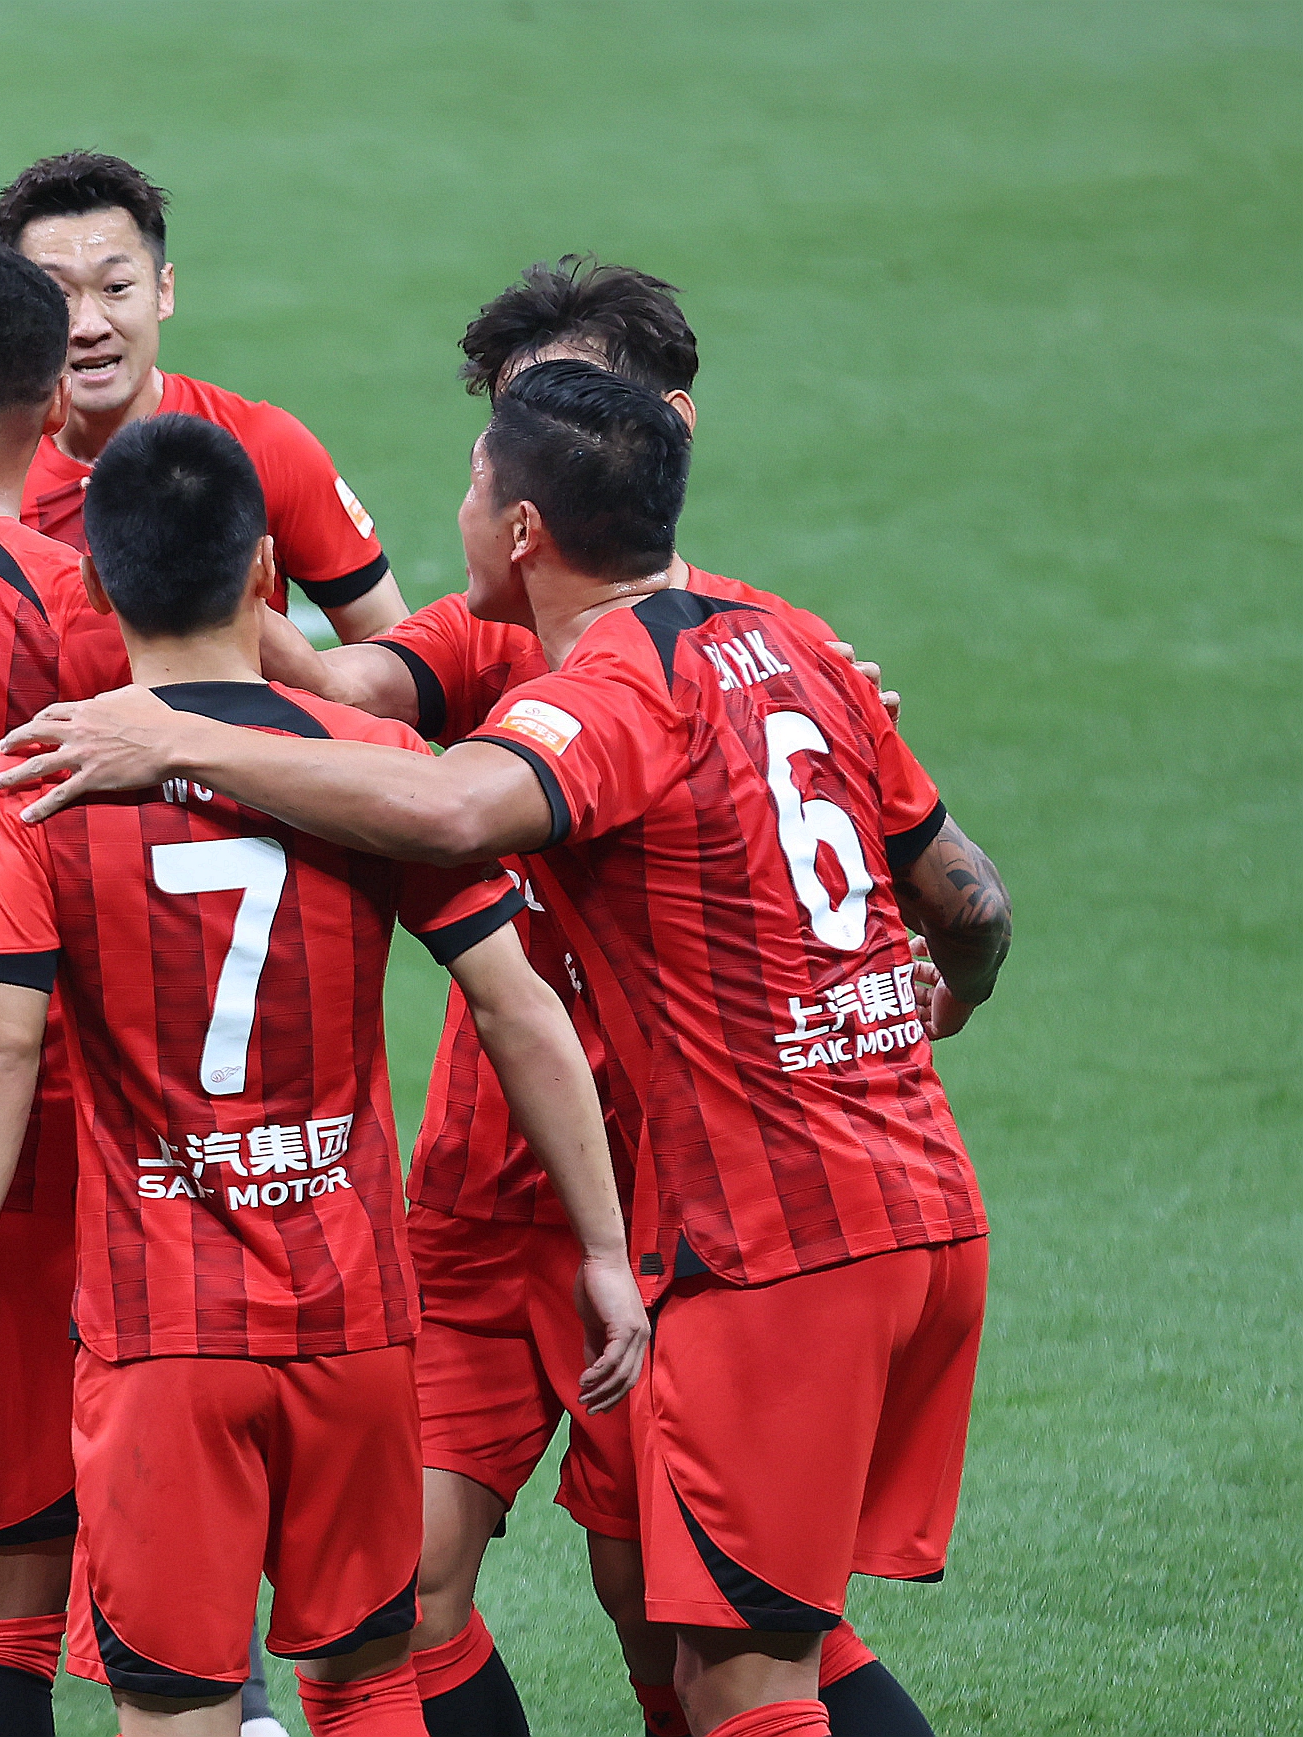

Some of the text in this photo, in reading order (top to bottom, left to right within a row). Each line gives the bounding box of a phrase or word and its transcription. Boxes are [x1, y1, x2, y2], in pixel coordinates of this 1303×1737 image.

[763, 710, 874, 952] 6
[151, 836, 287, 1096] 7
[774, 962, 917, 1043] 上汽集团
[778, 1037, 853, 1073] SAIC
[137, 1112, 354, 1178] 上汽集团
[227, 1166, 353, 1211] MOTOR
